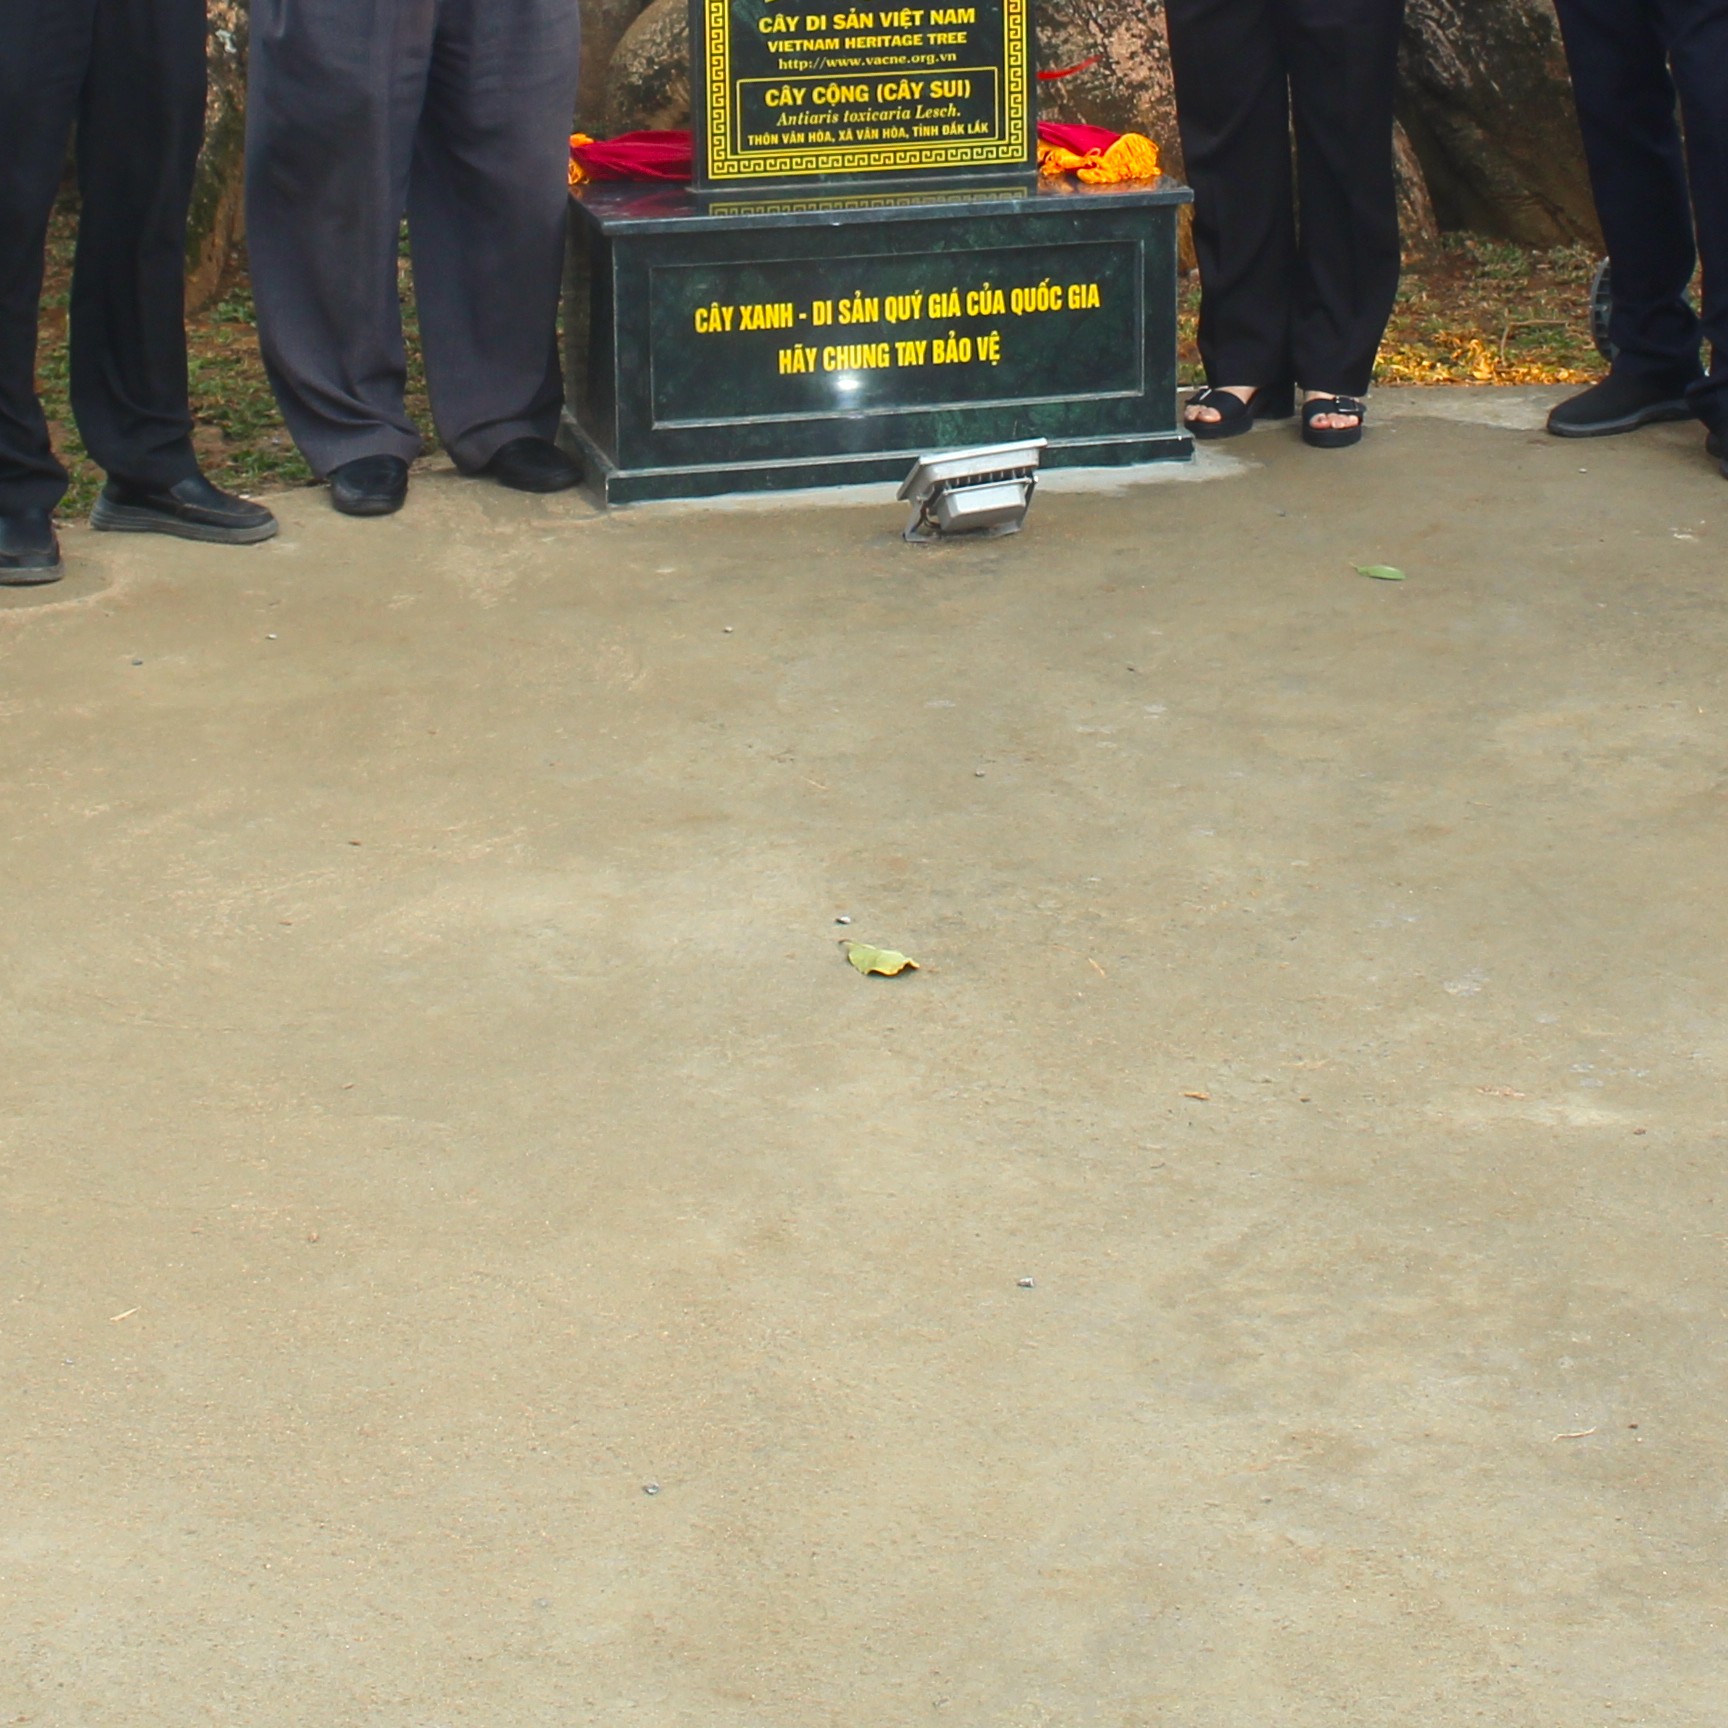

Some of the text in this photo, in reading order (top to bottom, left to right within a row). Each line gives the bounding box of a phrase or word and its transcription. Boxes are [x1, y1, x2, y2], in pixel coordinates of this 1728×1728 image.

[759, 8, 975, 34] CÂY DI SẢN VIỆT NAM
[768, 32, 967, 53] VIETNAM HERITAGE TREE
[779, 53, 957, 71] http://www.vacne.org.vn
[765, 79, 970, 107] CÂY CỘNG (CÂY SUI)
[776, 103, 961, 126] Antiaris toxicaria Lesch.
[747, 132, 779, 146] THÔN
[782, 131, 805, 144] VÂN
[808, 129, 836, 144] HÒA,
[838, 128, 853, 141] XÃ
[856, 127, 879, 140] VÂN
[882, 125, 910, 139] HÒA,
[912, 123, 939, 137] TỈNH
[694, 301, 734, 334] CÂY
[739, 302, 793, 331] XANH
[812, 300, 833, 326] DI
[838, 290, 879, 325] SẢN
[884, 289, 923, 324] QUÝ
[928, 287, 962, 319] GIÁ
[966, 282, 1006, 317] CỦA
[1010, 277, 1063, 316] QUỐC
[1068, 283, 1101, 310] GIA
[778, 330, 1001, 375] HÃY CHUNG TAY BẢO VỆ
